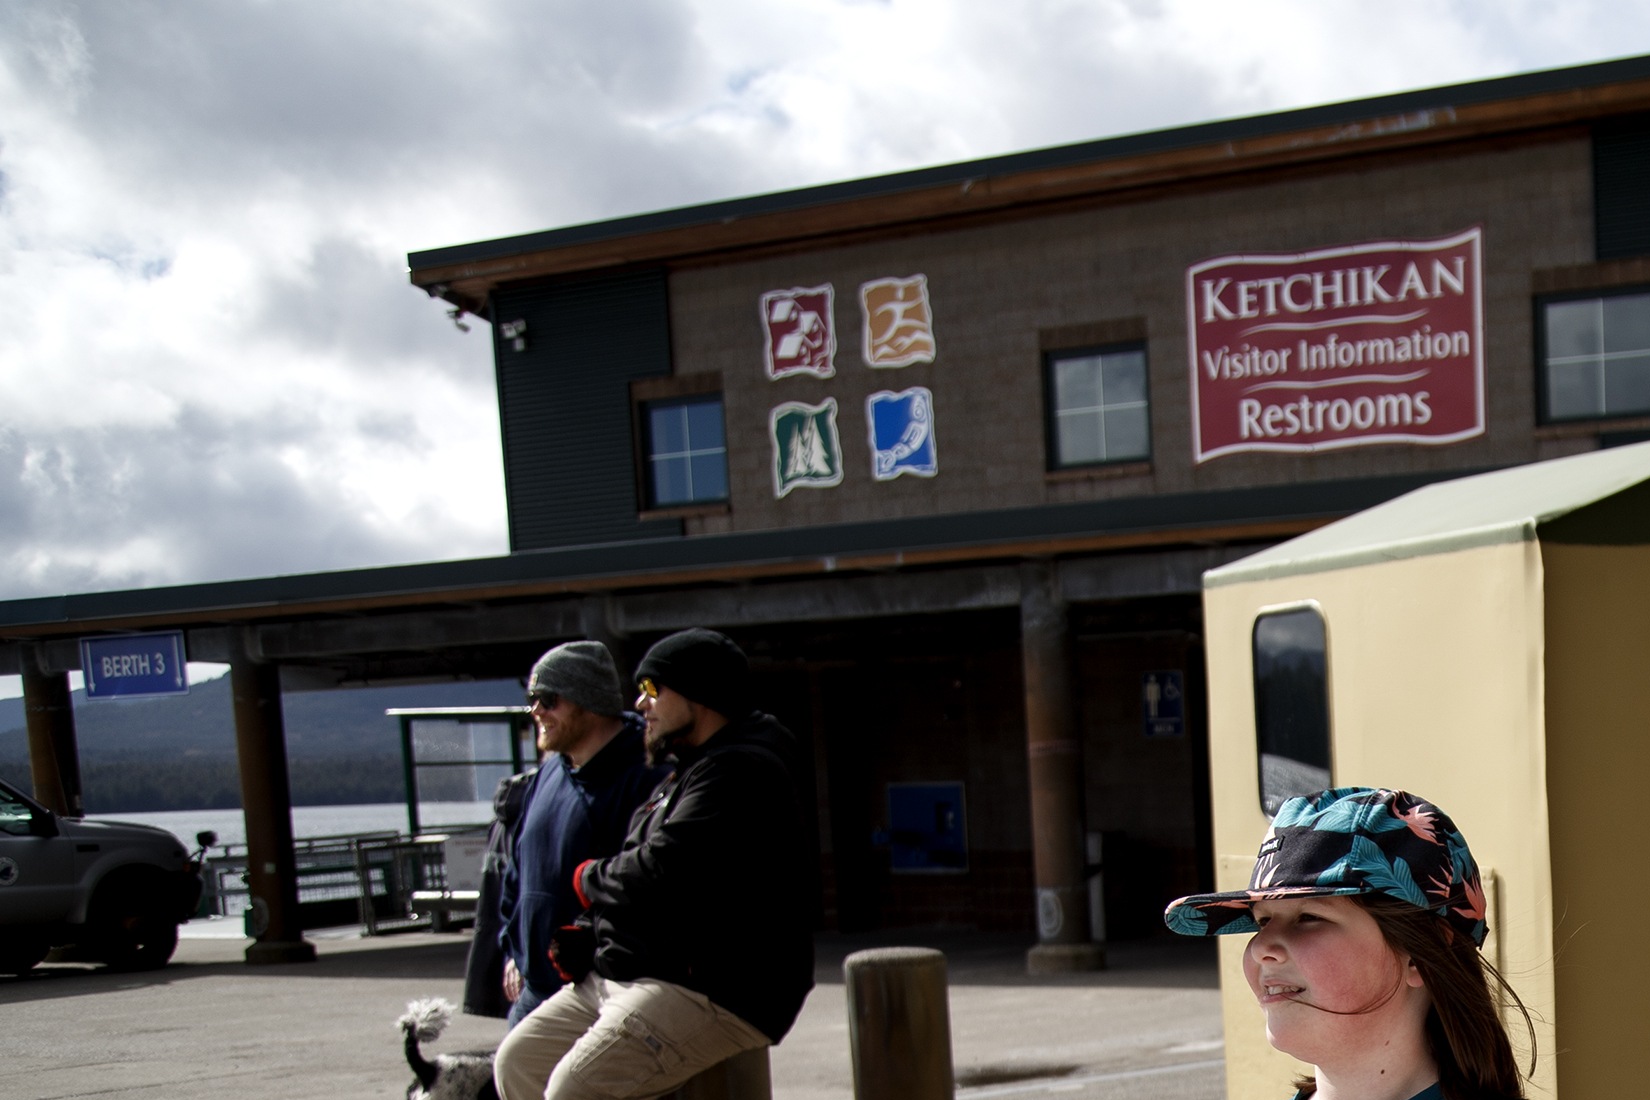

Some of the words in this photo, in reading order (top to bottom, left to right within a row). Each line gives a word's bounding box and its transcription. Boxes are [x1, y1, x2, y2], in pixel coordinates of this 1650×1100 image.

[1201, 255, 1466, 323] KETCHIKAN
[1204, 345, 1291, 380] Visitor
[1298, 325, 1470, 371] Information
[1239, 391, 1432, 439] Restrooms
[102, 654, 150, 678] BERTH
[155, 653, 165, 674] 3
